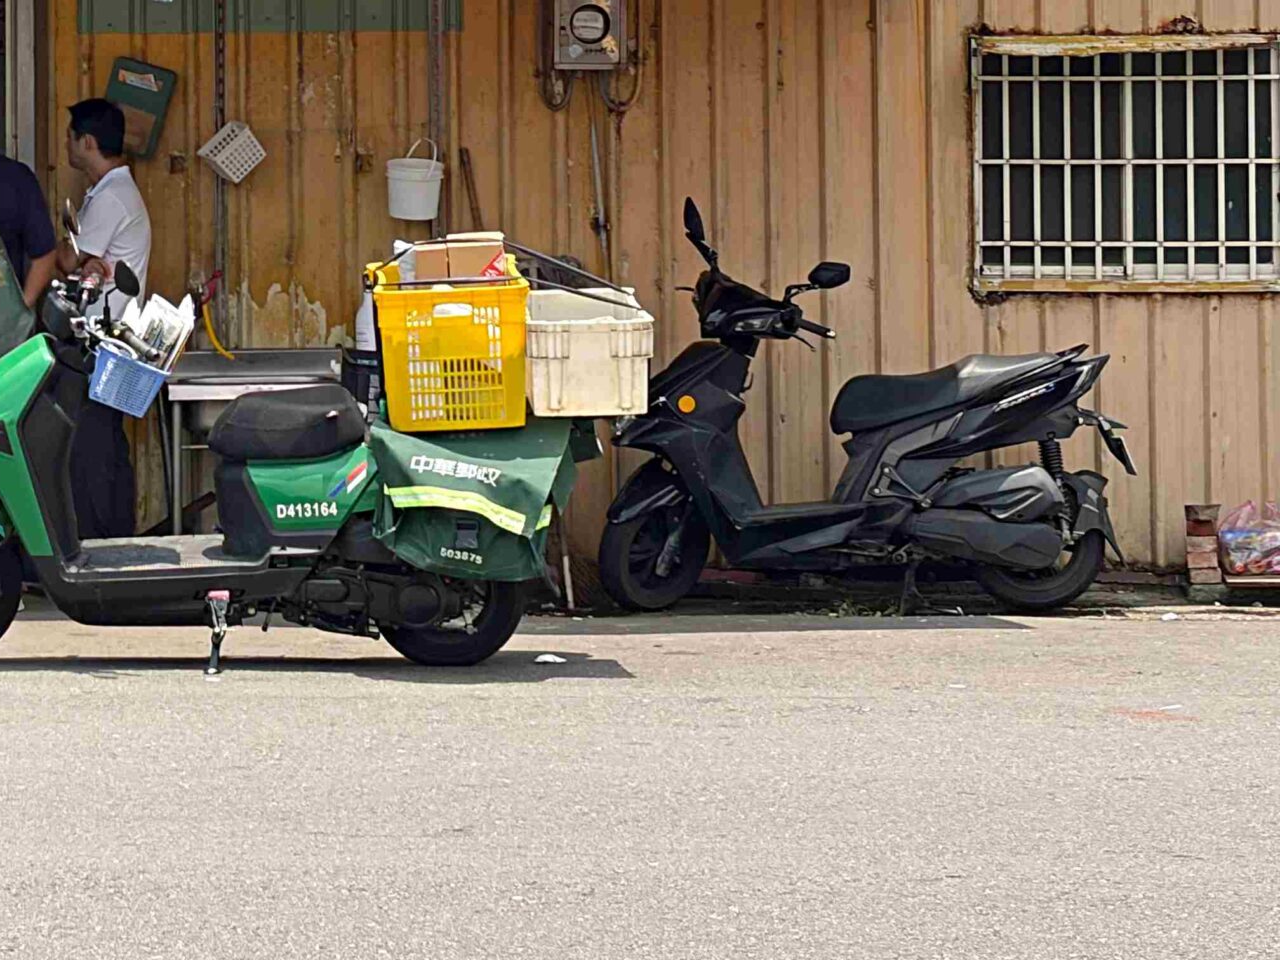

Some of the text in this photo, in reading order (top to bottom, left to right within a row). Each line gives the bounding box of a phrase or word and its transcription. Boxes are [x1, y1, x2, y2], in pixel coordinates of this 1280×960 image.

[410, 454, 502, 487] 中華郵政
[276, 501, 338, 519] D413164
